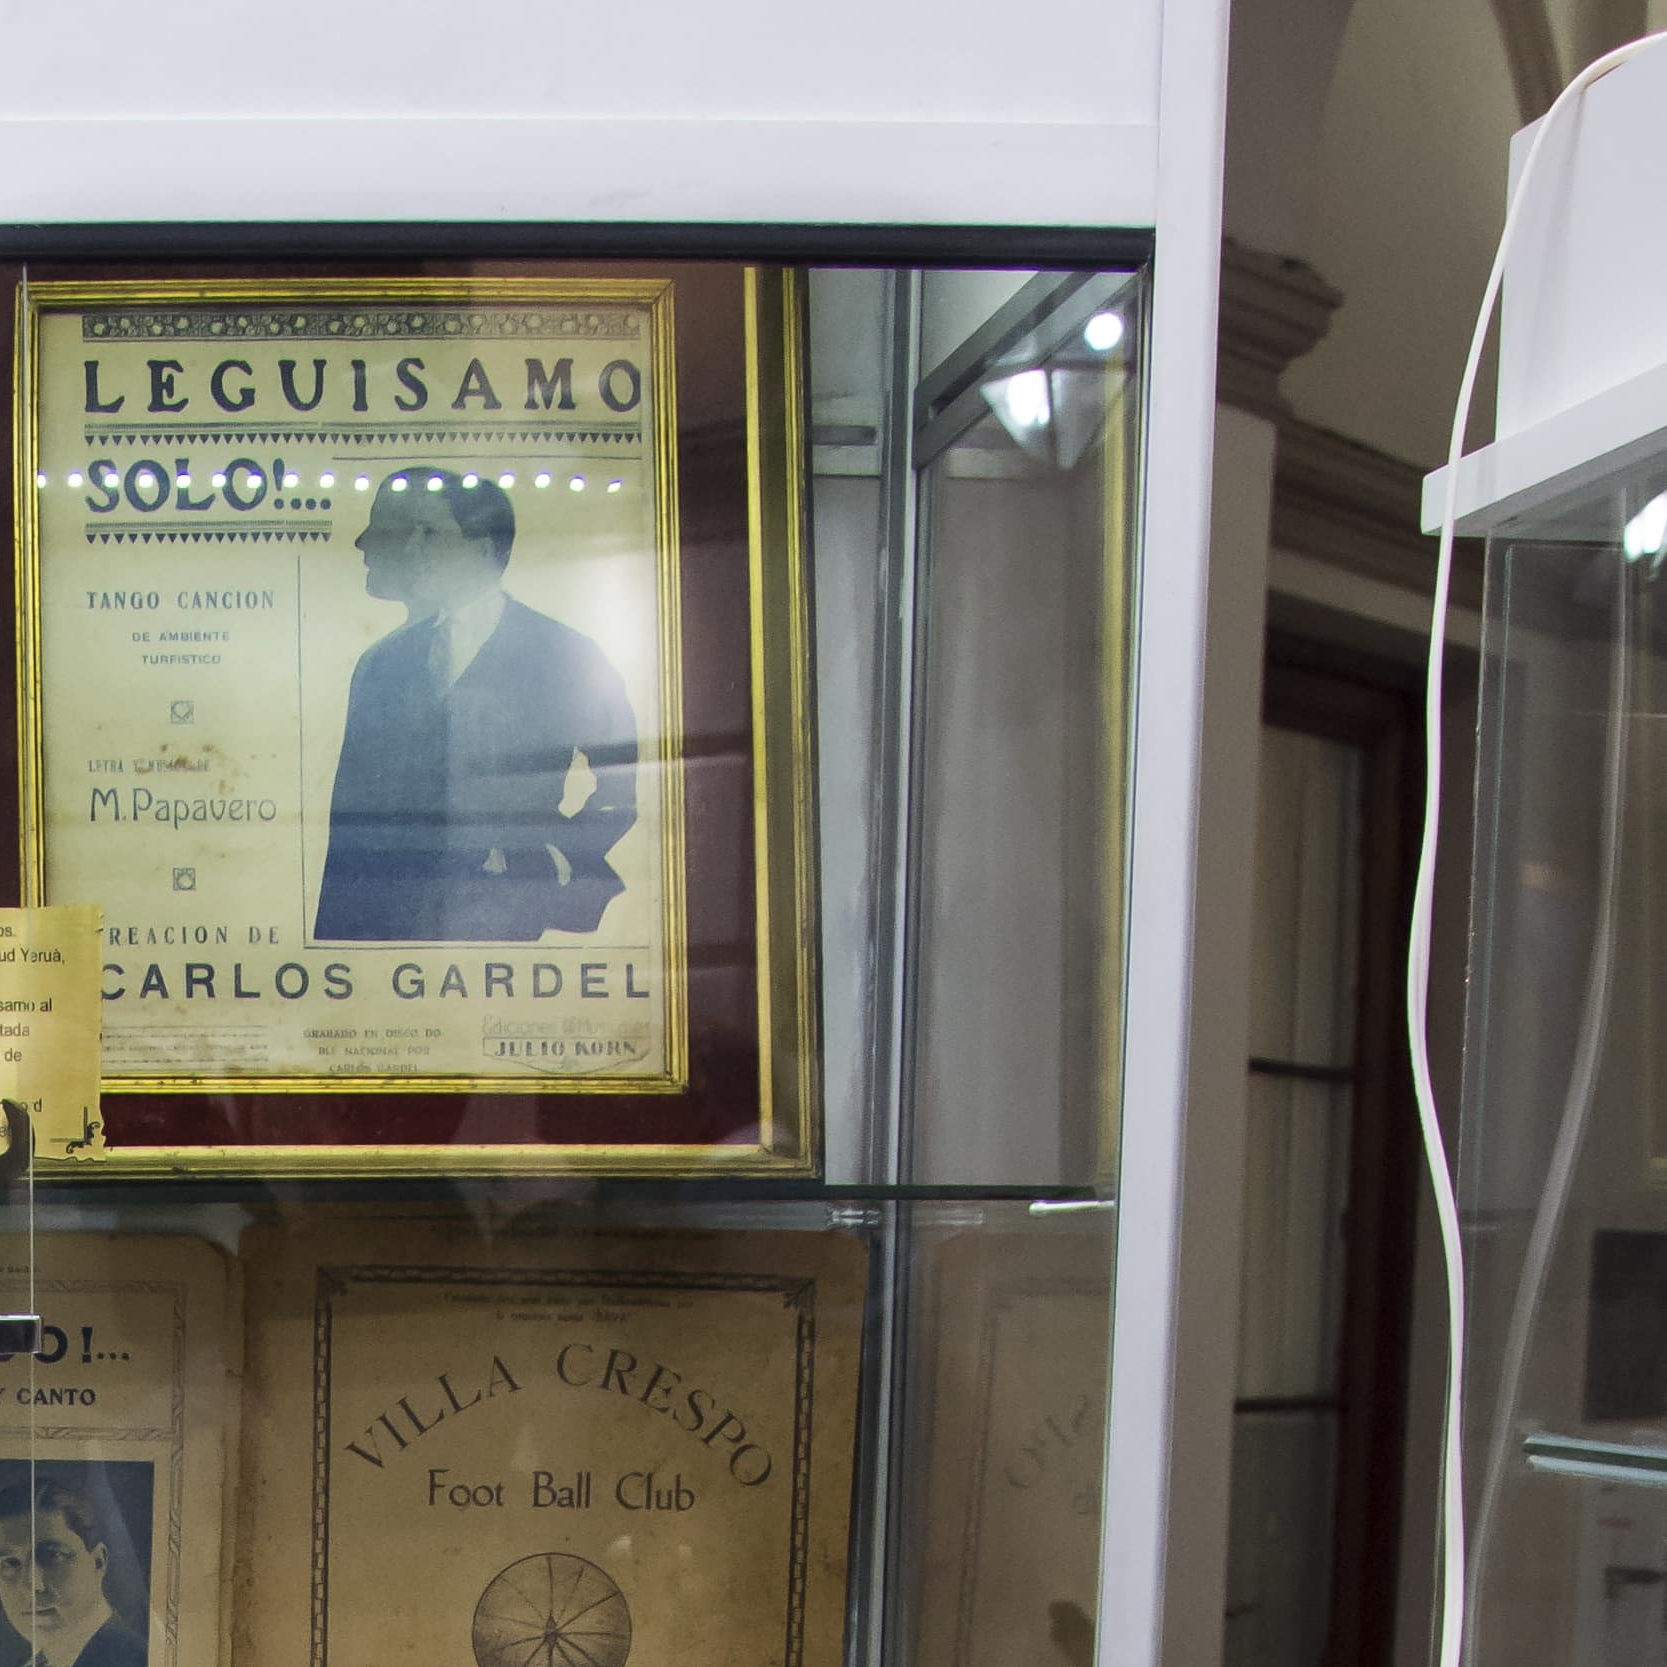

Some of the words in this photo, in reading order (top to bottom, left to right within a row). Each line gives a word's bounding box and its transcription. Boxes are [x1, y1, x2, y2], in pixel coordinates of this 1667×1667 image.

[84, 357, 642, 414] LEGUISAMO
[87, 591, 160, 609] TANGO
[177, 590, 275, 609] CANCION
[132, 632, 150, 642] DE
[159, 631, 230, 642] AMBIENTE
[142, 654, 221, 665] TURFISTICO
[108, 926, 228, 945] REACION
[249, 926, 279, 944] DE
[101, 962, 354, 1000] CARLOS
[392, 963, 650, 999] GARDEL
[40, 998, 52, 1013] al
[4, 1048, 22, 1062] de
[16, 1387, 96, 1405] CANTO
[343, 1353, 524, 1477] VILLA
[555, 1341, 775, 1489] CRESPO
[427, 1468, 505, 1511] Foot
[532, 1469, 592, 1511] Ball
[615, 1470, 696, 1512] Club
